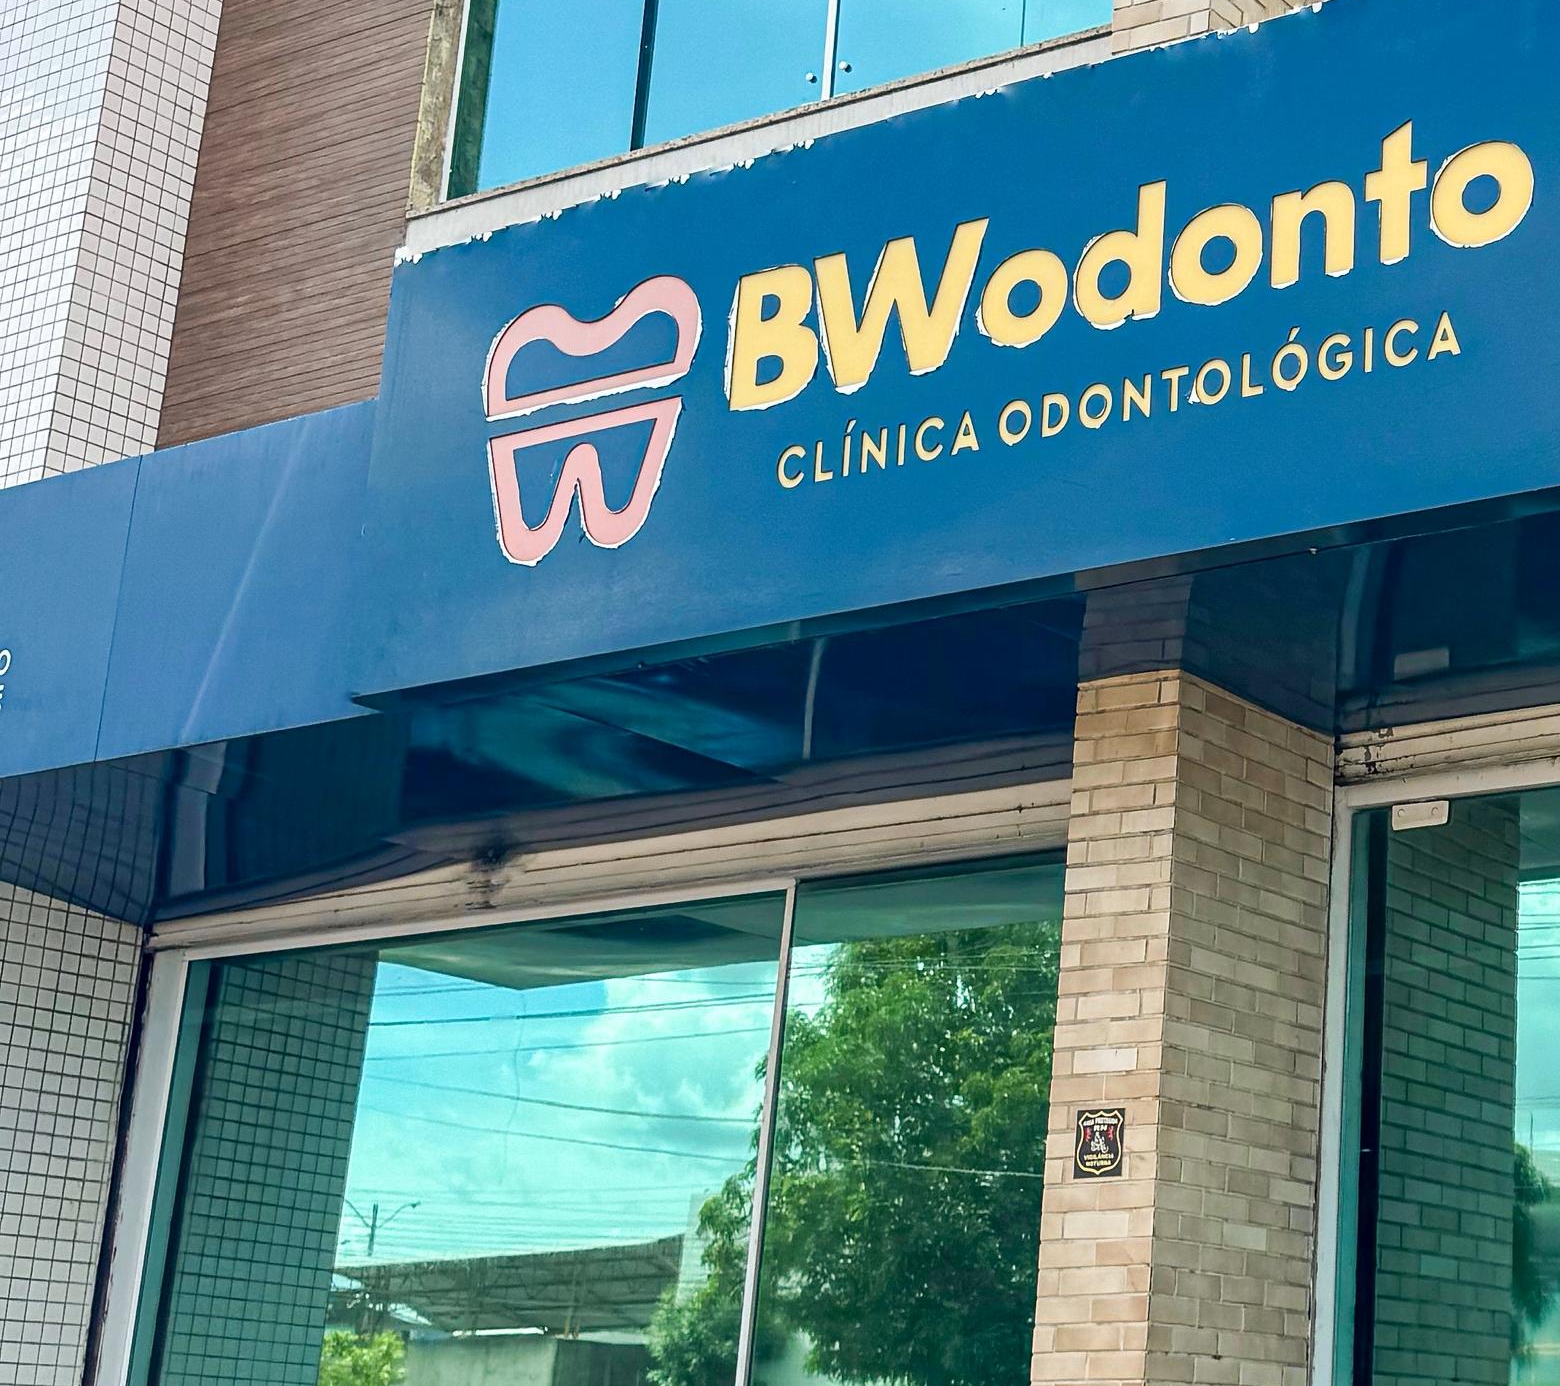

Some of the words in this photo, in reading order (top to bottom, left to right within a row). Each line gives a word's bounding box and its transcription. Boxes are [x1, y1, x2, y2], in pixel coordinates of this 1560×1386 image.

[727, 119, 1536, 412] BWodonto
[776, 410, 979, 489] CLÍNICA
[998, 310, 1462, 446] ODONTOLÓGICA
